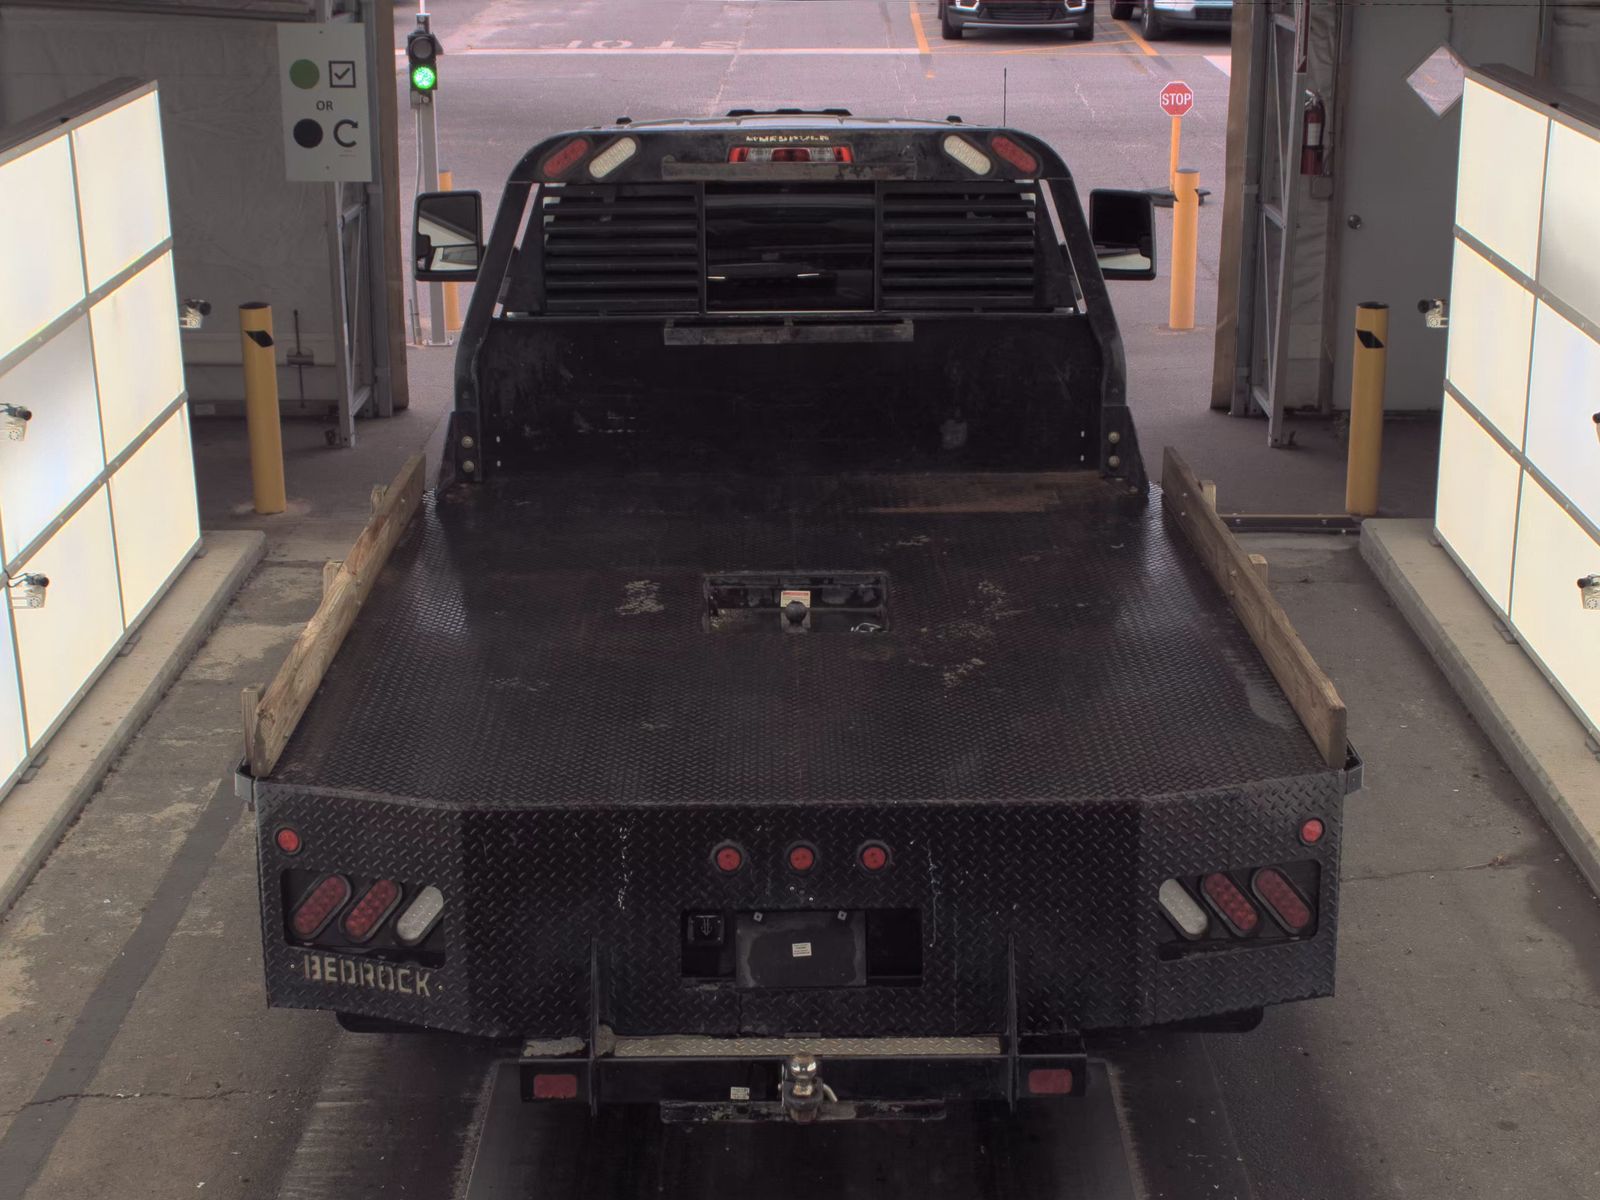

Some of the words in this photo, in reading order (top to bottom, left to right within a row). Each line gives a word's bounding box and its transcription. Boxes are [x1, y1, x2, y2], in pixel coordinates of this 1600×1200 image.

[315, 100, 334, 111] OR
[1162, 92, 1191, 106] STOP
[304, 954, 431, 997] BEDROCK
